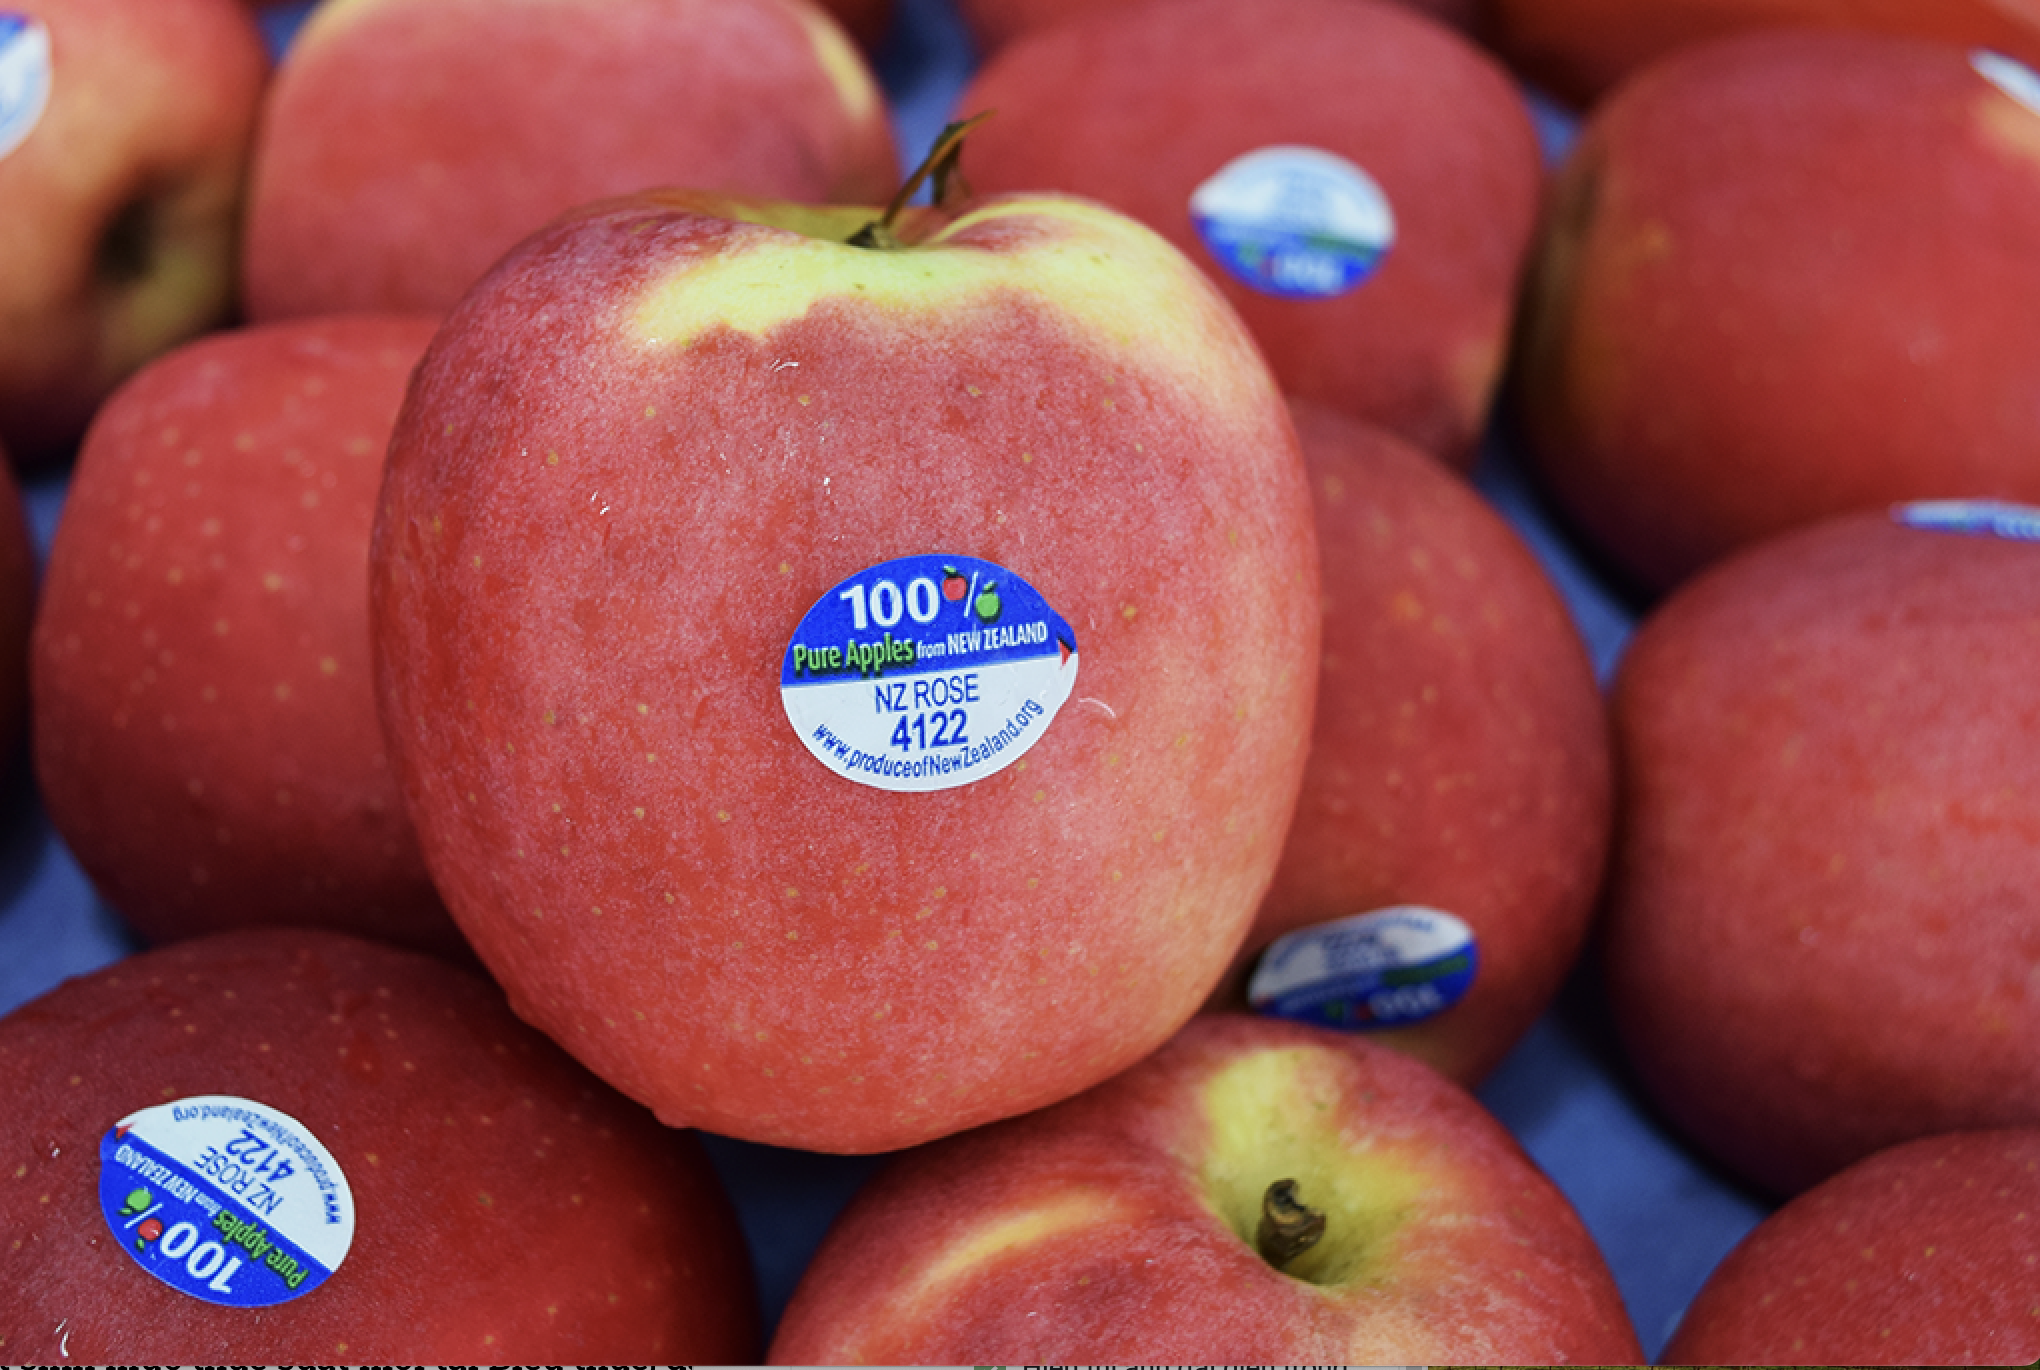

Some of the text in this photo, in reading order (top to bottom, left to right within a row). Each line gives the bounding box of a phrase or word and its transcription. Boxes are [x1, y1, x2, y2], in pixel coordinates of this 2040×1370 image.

[793, 621, 1048, 677] Pure Apples from NEW ZEALAND
[874, 674, 980, 714] NZ ROSE
[811, 699, 1045, 778] www.produceofNewZealand.org
[890, 708, 969, 752] 4122
[193, 1145, 284, 1216] NZ ROSE
[225, 1128, 295, 1182] 4122
[211, 1209, 273, 1261] Apples
[265, 1246, 310, 1290] Pure
